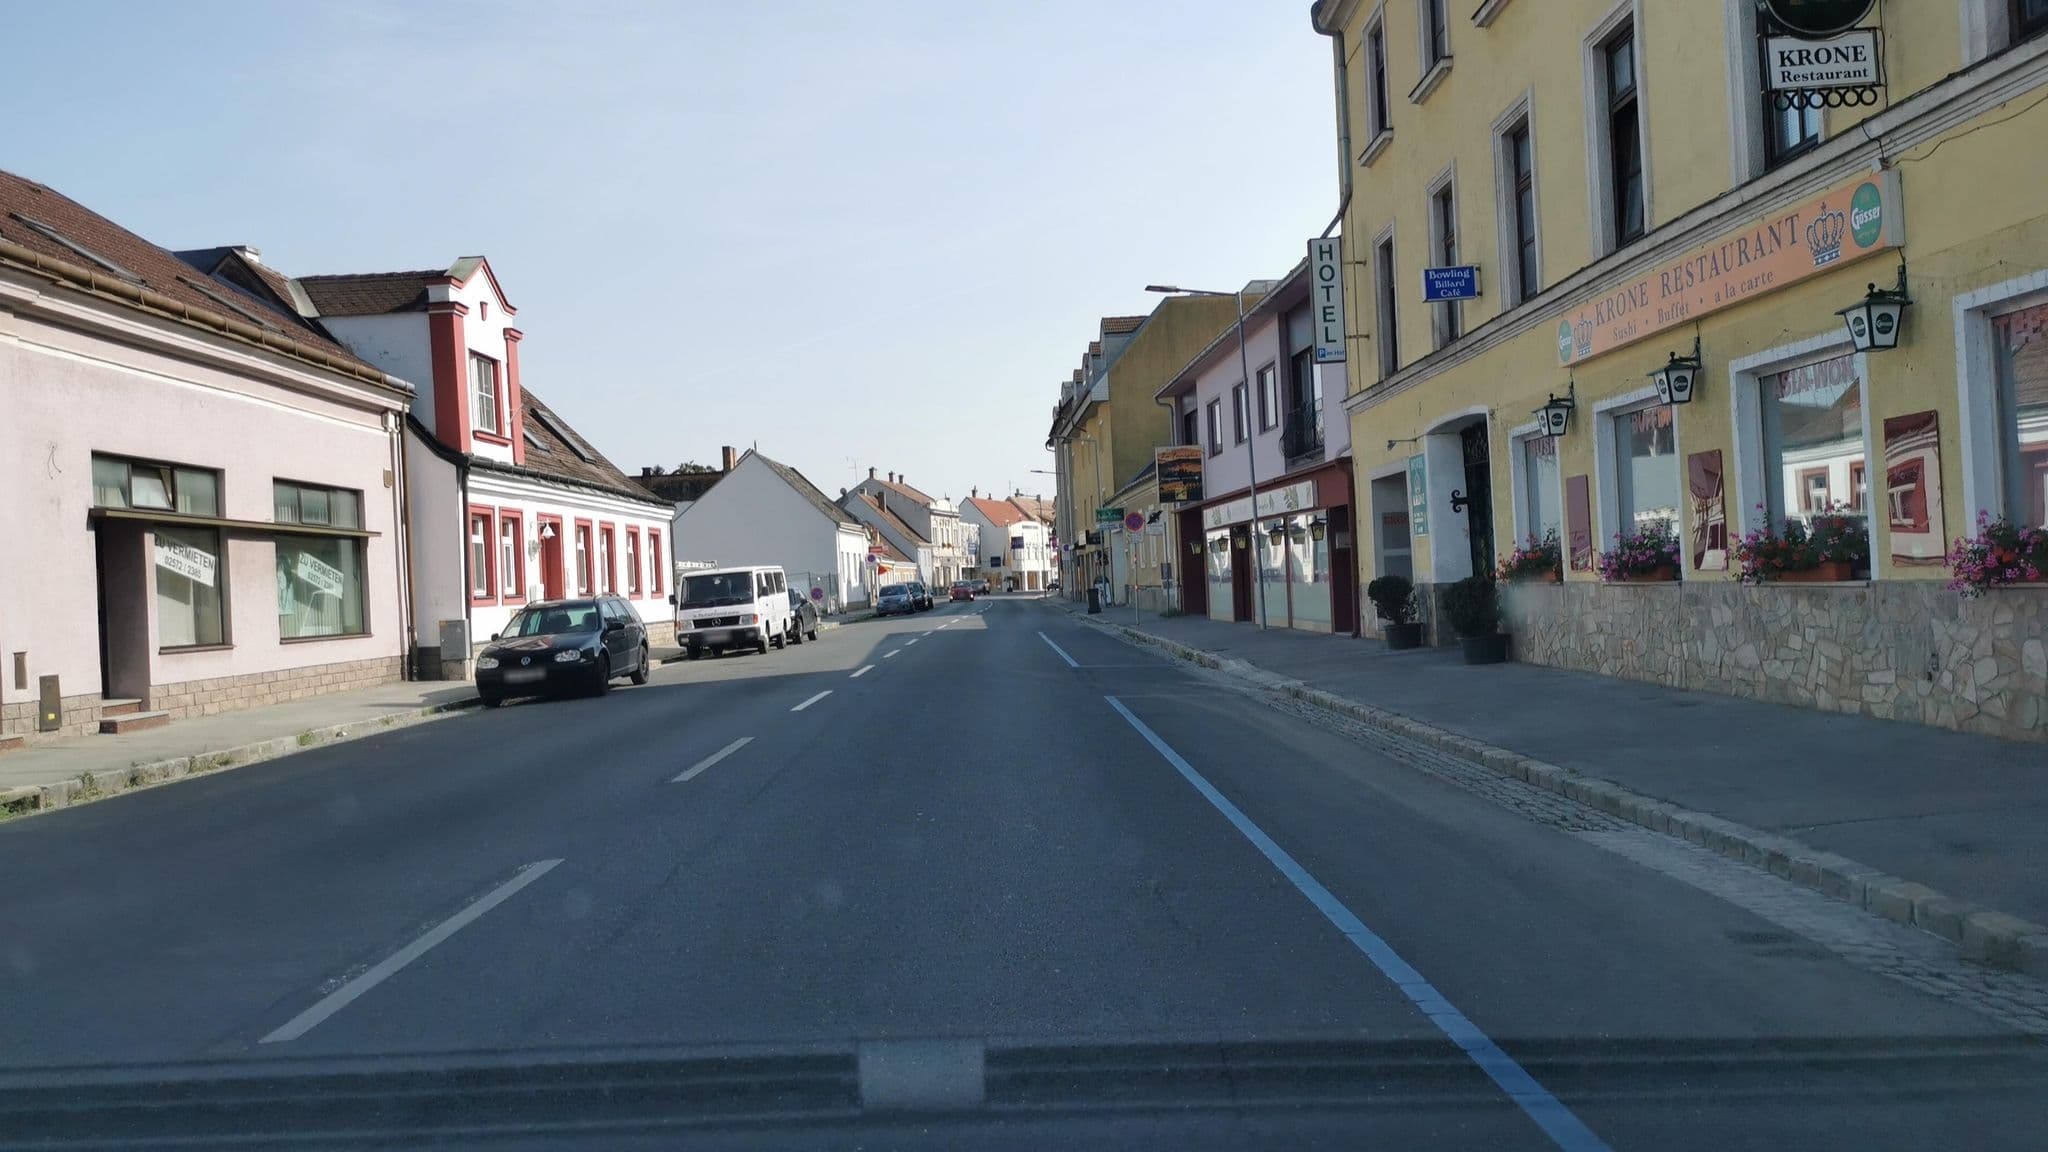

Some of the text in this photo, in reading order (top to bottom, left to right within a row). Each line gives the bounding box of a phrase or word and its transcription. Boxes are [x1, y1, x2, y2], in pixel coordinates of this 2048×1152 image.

[1778, 45, 1867, 67] KRONE
[1781, 68, 1869, 83] Restaurant
[1851, 206, 1880, 230] Gösser
[1429, 269, 1471, 280] Bowling
[1594, 213, 1800, 327] KRONE RESTAURANT
[1319, 244, 1337, 343] HOTEL
[1435, 280, 1465, 289] Billard
[1440, 288, 1461, 298] Café
[1613, 271, 1774, 341] Sushi Buffet a la carte
[155, 533, 214, 571] ZU VERMIETEN
[165, 556, 183, 571] 02572
[300, 553, 343, 585] ZU VERMIETEN
